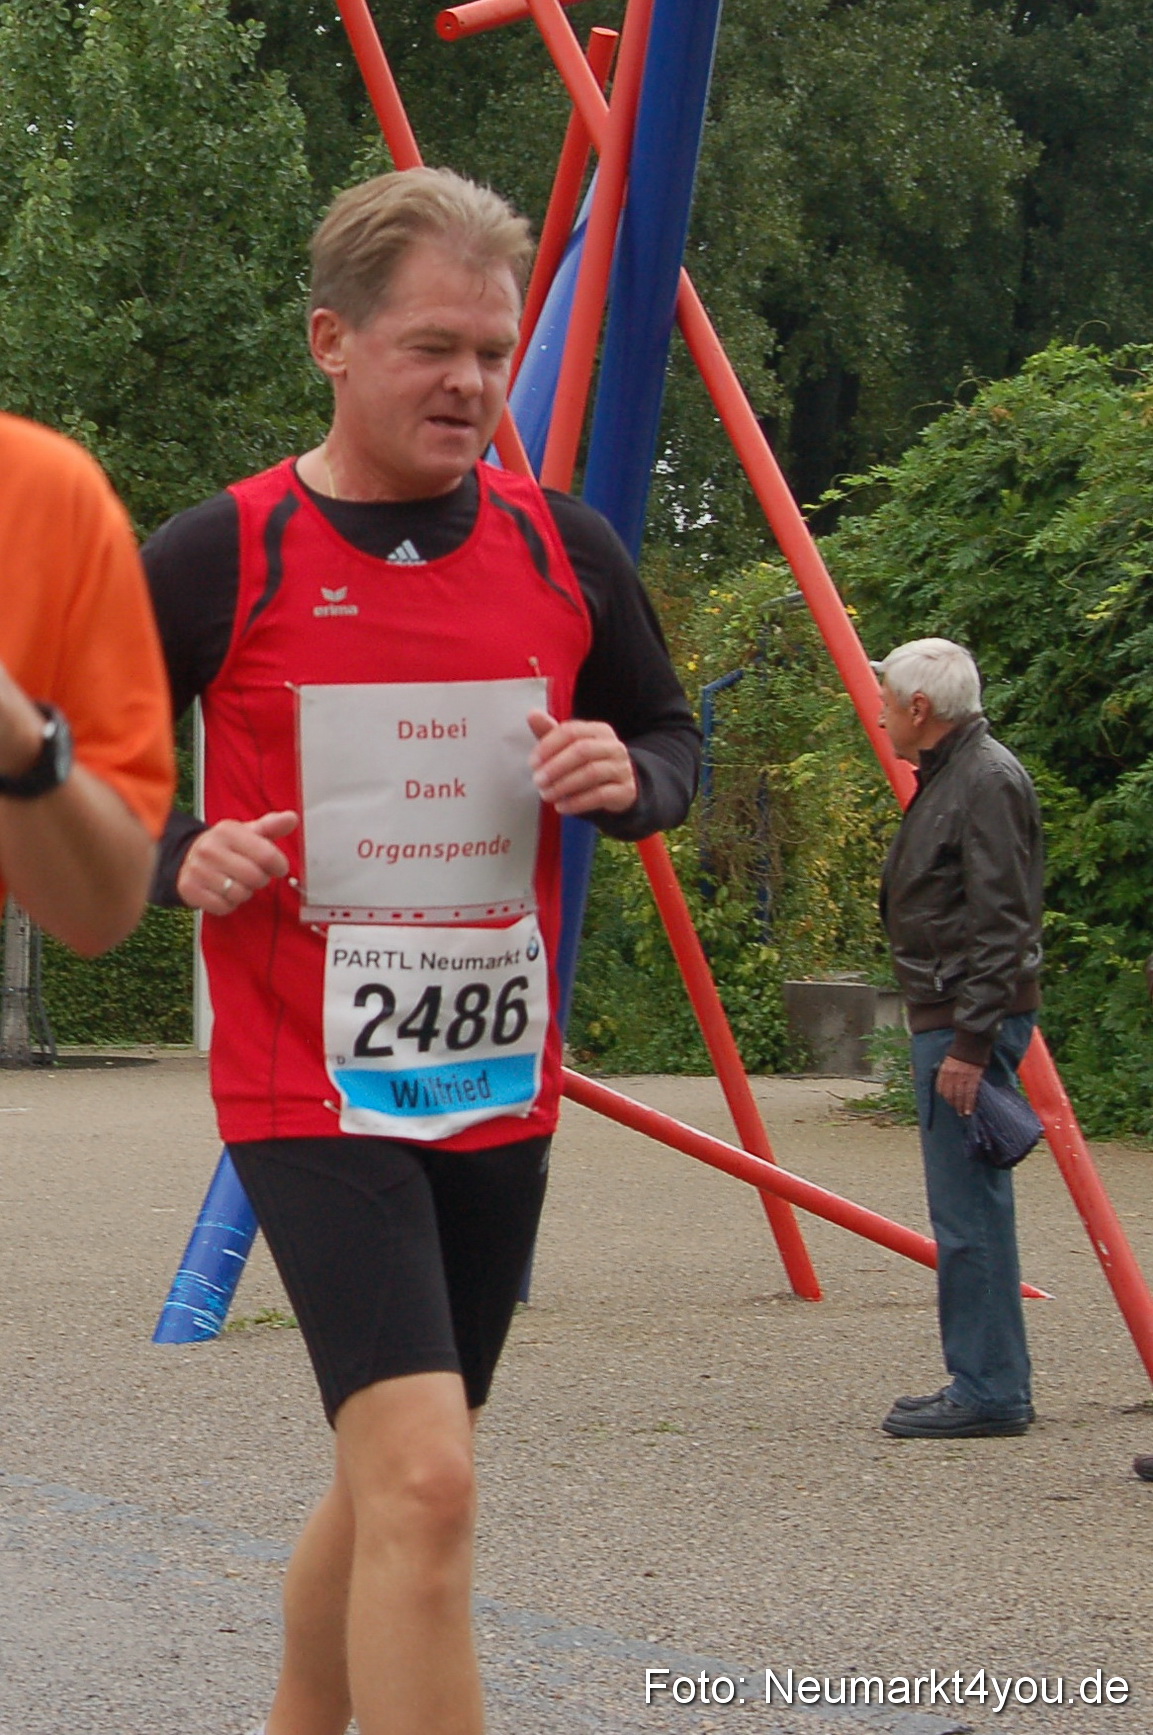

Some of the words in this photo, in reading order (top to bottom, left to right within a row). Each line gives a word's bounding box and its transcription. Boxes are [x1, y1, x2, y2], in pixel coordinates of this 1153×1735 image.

[397, 717, 468, 740] Dabei
[405, 777, 466, 799] Dank
[357, 834, 511, 864] Organspende
[333, 949, 412, 970] PARTL
[420, 949, 520, 971] Neumarkt
[353, 975, 529, 1058] 2486
[390, 1070, 491, 1109] Wilfried
